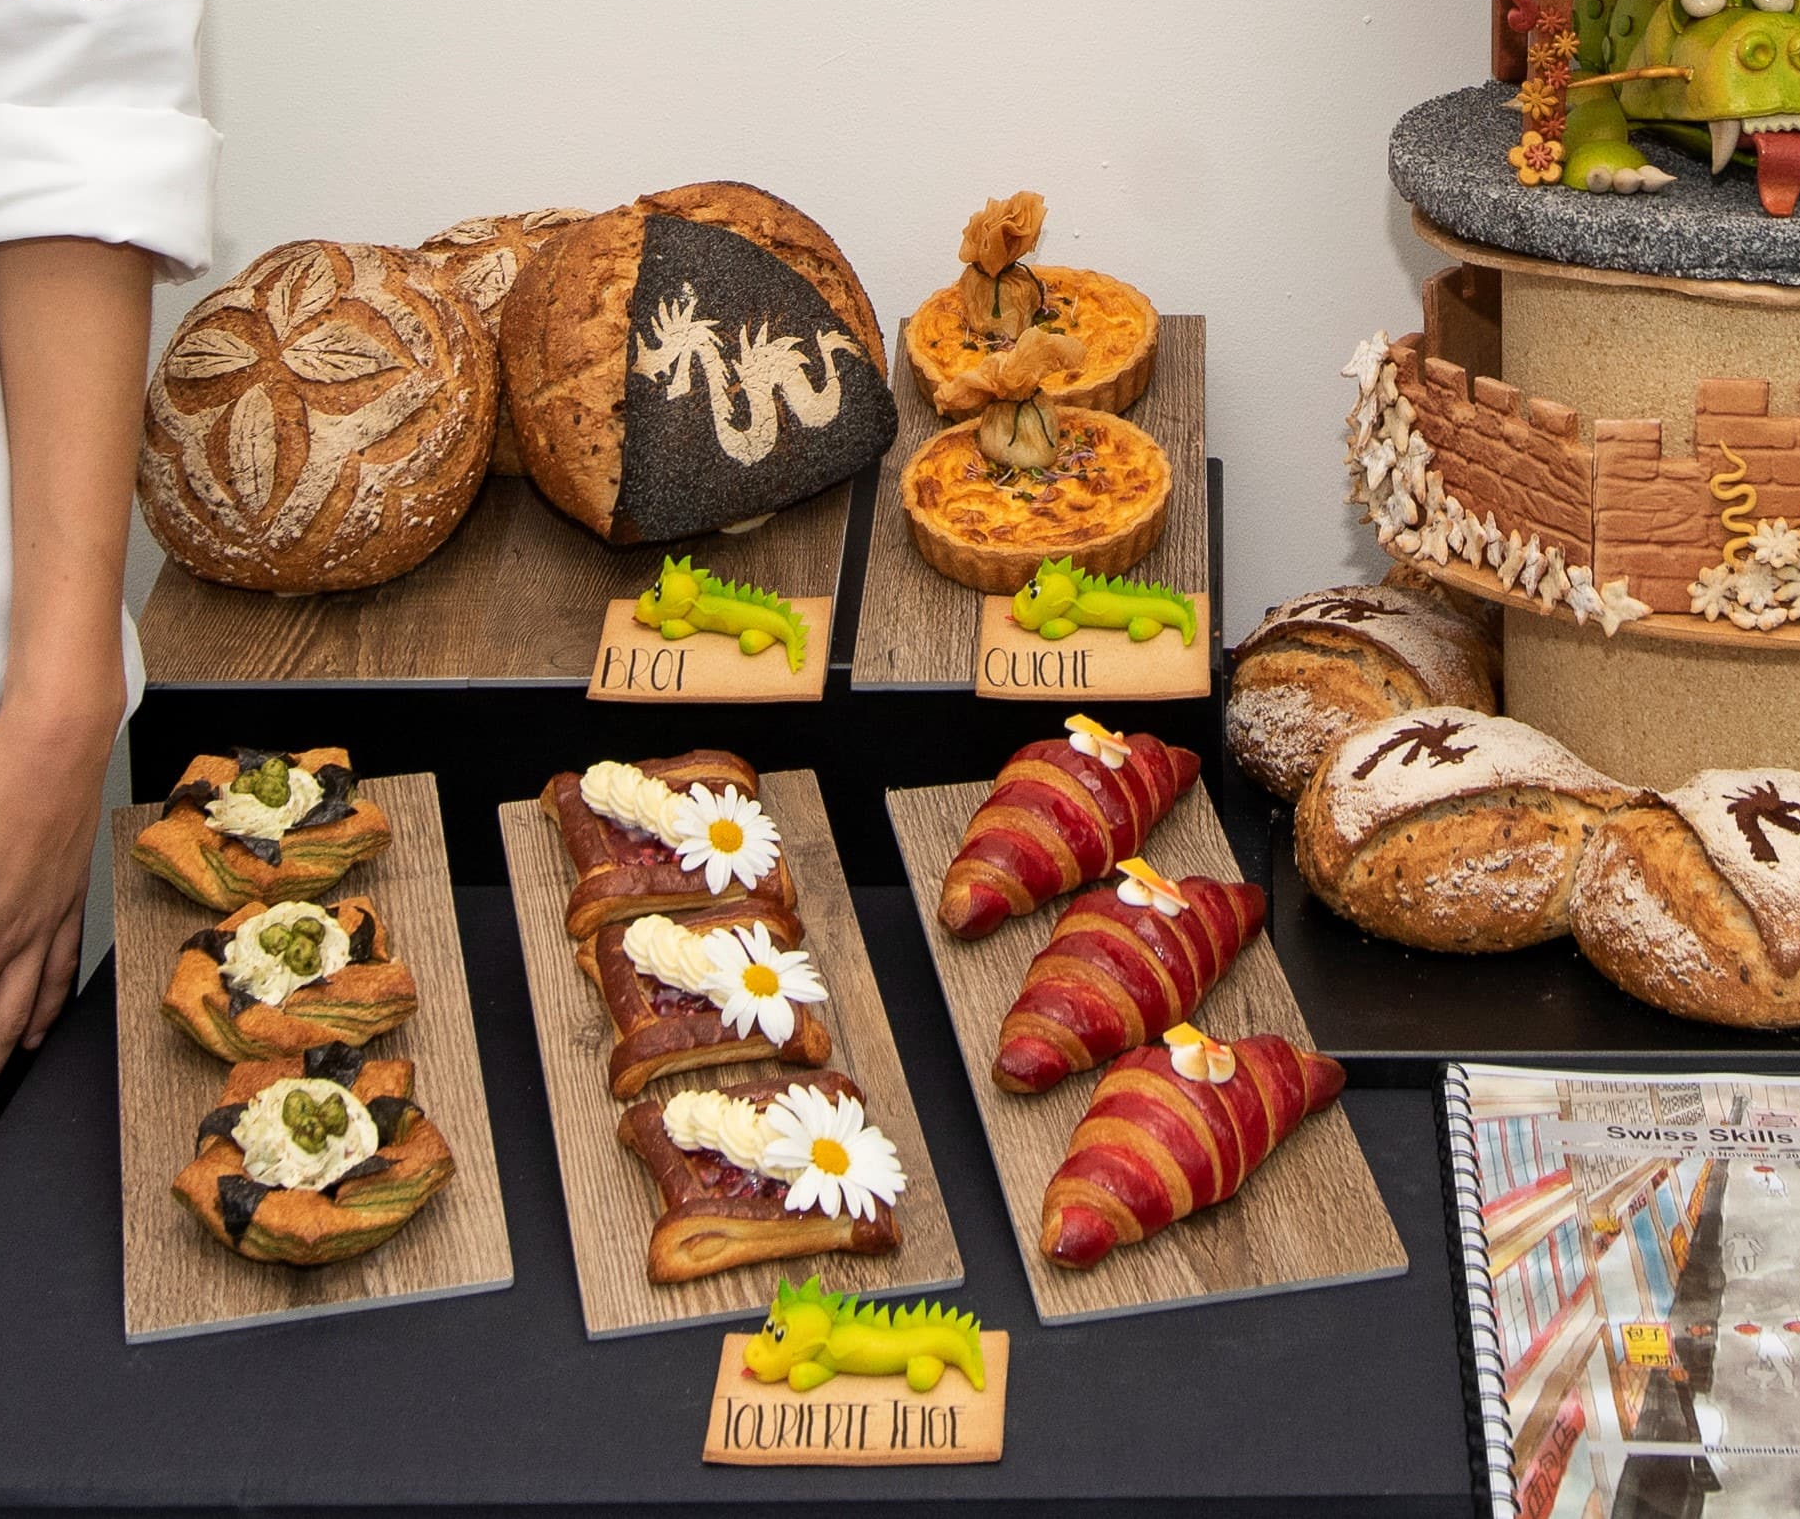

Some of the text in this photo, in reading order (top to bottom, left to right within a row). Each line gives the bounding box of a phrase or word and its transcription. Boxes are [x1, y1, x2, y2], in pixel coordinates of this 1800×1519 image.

[600, 645, 695, 691] BROT
[984, 647, 1096, 689] QUICHE
[1606, 1125, 1698, 1142] Swiss
[1708, 1127, 1794, 1145] Skills
[718, 1395, 879, 1451] TOURIERTE
